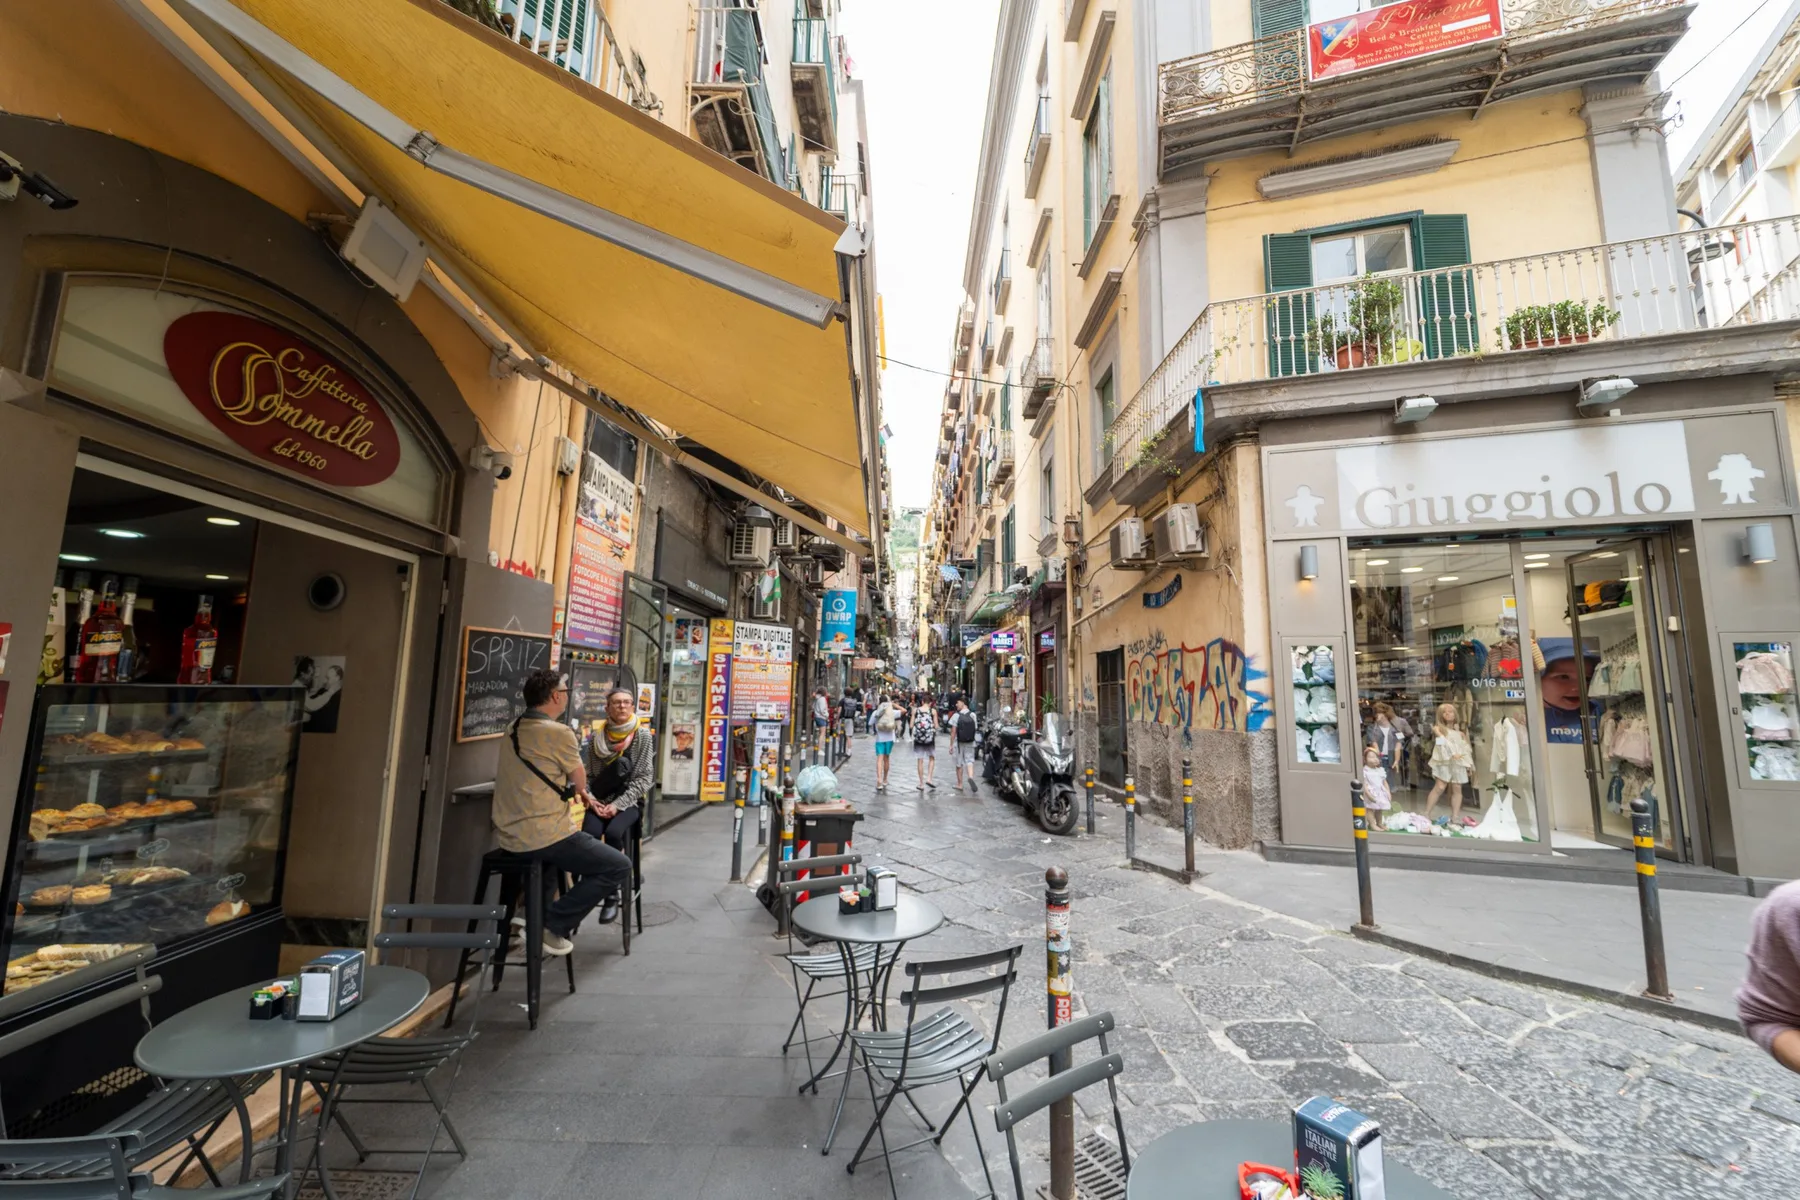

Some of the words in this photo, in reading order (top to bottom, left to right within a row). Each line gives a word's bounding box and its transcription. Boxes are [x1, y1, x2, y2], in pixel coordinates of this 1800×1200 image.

[1369, 34, 1386, 44] Bed
[1399, 21, 1441, 36] Breakfast
[1410, 30, 1439, 41] Centro
[278, 348, 368, 414] Caffetteria
[210, 341, 378, 460] Sommella
[273, 438, 300, 457] dal
[297, 451, 328, 471] 1960
[610, 480, 632, 514] DIGITALE
[1355, 471, 1672, 529] Giuggiolo
[90, 632, 122, 643] APERO
[735, 626, 761, 640] STAMPA
[763, 629, 791, 643] DIGITALE
[710, 653, 727, 715] STAMPA
[1472, 678, 1496, 688] 0/16
[1500, 678, 1525, 688] anni
[706, 719, 724, 782] DIGITALE
[1304, 1127, 1337, 1153] ITALIAN
